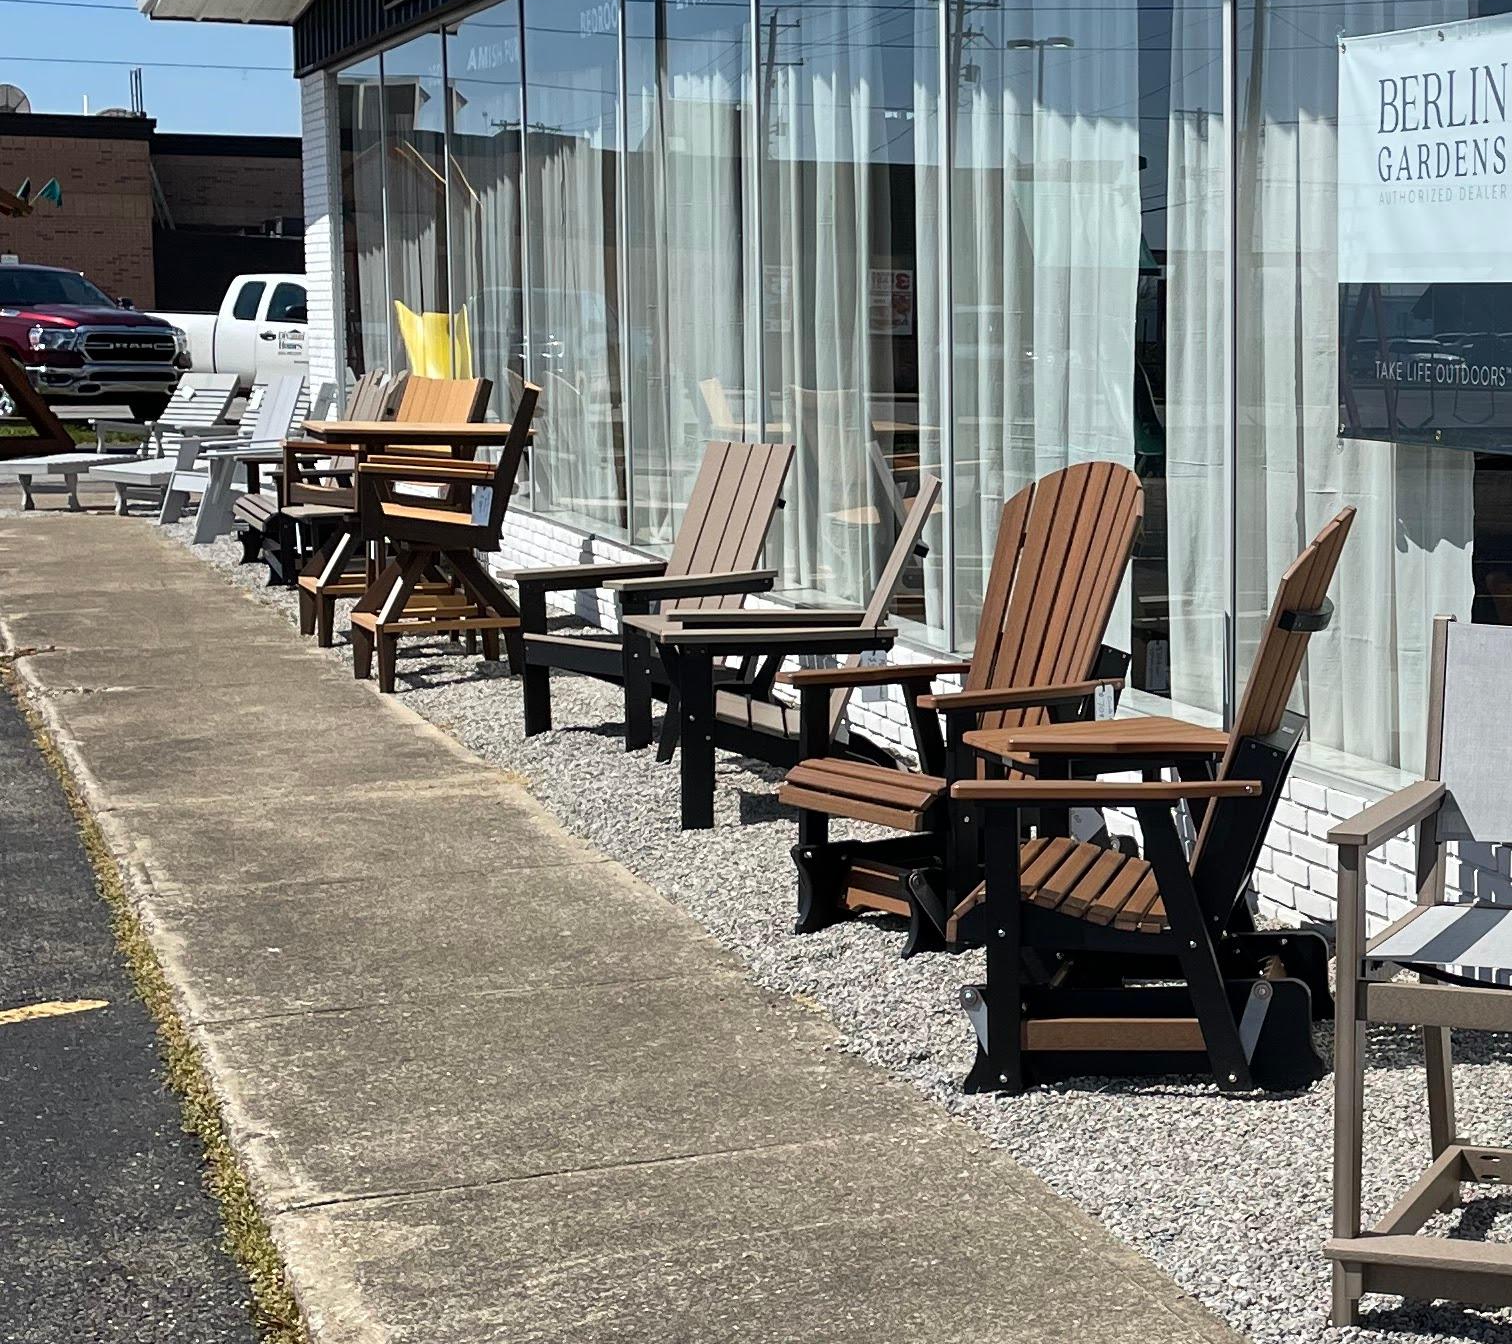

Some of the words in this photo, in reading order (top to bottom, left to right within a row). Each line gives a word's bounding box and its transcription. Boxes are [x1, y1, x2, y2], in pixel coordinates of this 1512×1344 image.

[1377, 62, 1509, 134] BERLIN
[1377, 135, 1507, 183] GARDENS
[1378, 187, 1453, 206] AUTHORIZED
[1459, 183, 1508, 202] DEALER
[114, 342, 153, 350] RAM
[1375, 360, 1403, 382] TAKE
[1406, 362, 1432, 384] LIFE
